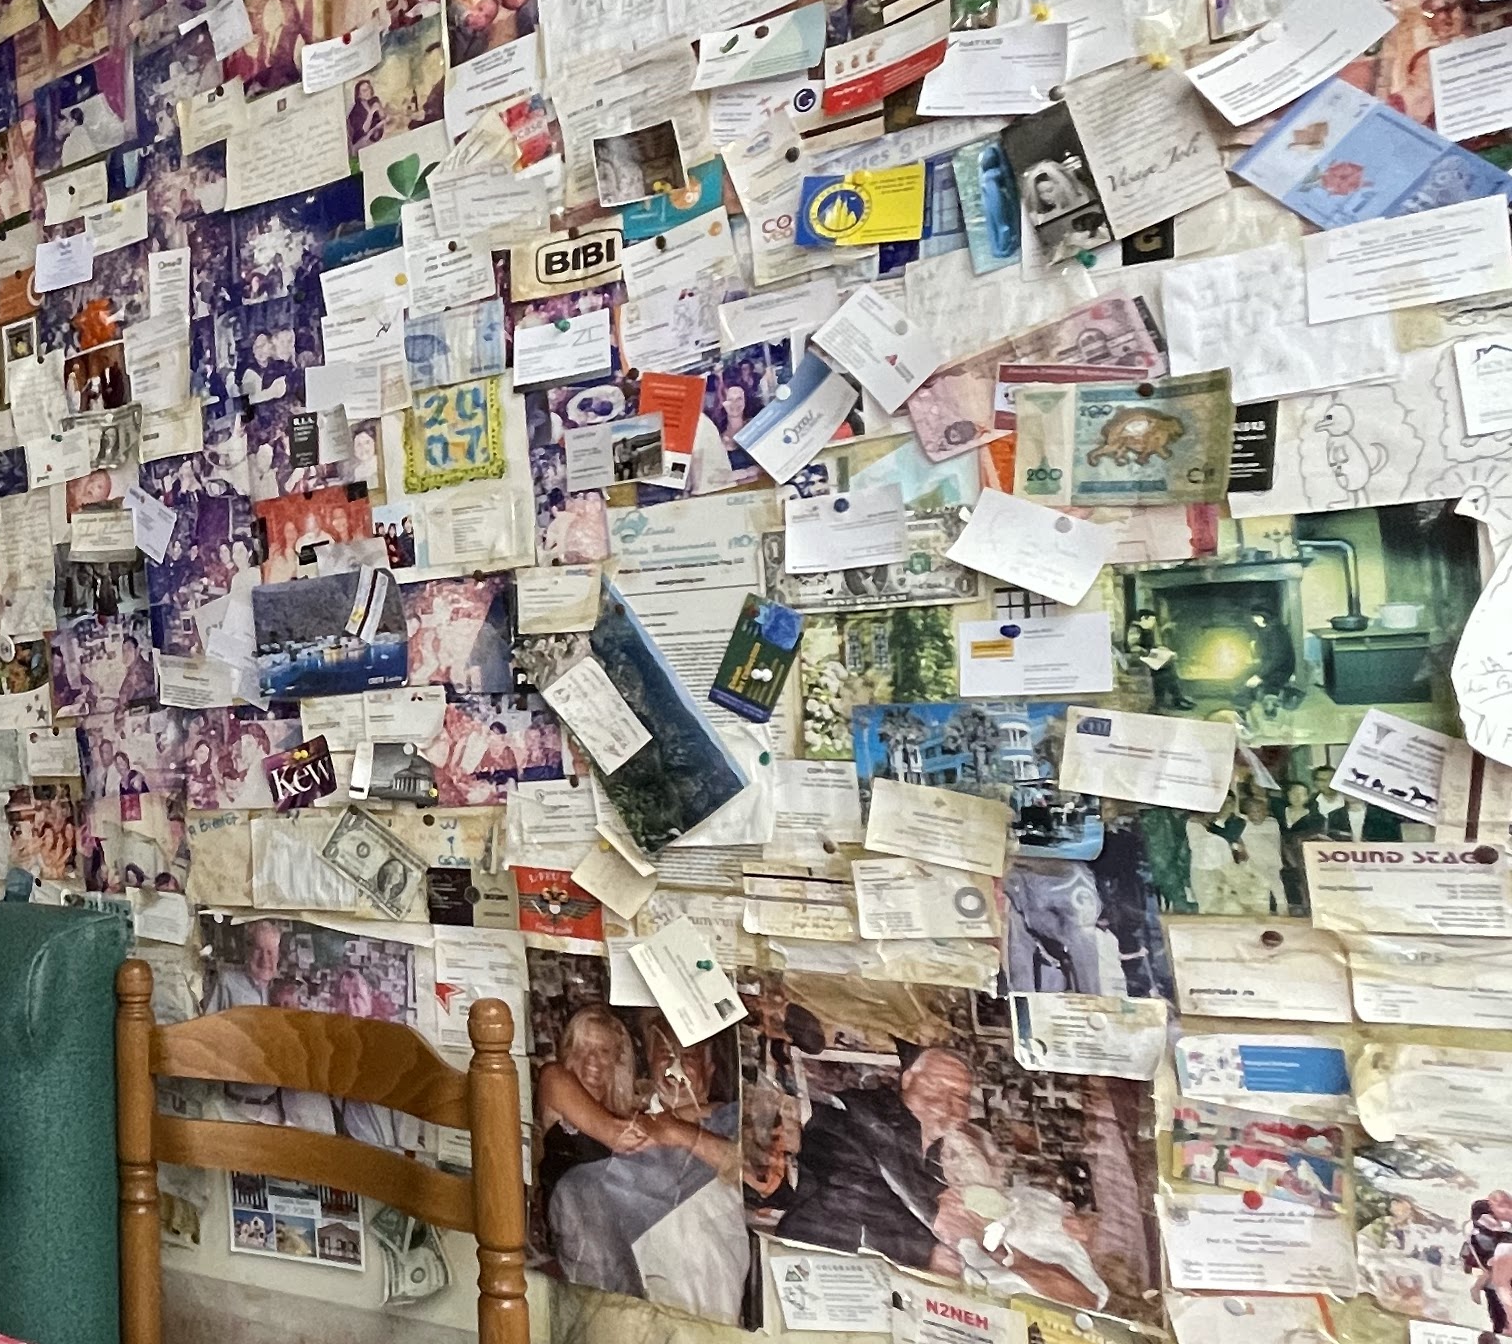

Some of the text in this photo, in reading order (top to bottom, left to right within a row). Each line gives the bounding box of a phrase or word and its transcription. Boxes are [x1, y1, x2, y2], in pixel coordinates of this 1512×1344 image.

[544, 238, 616, 276] BIBI
[1026, 467, 1062, 482] 200
[271, 756, 332, 800] Kew
[1317, 849, 1484, 865] SOUND STAG
